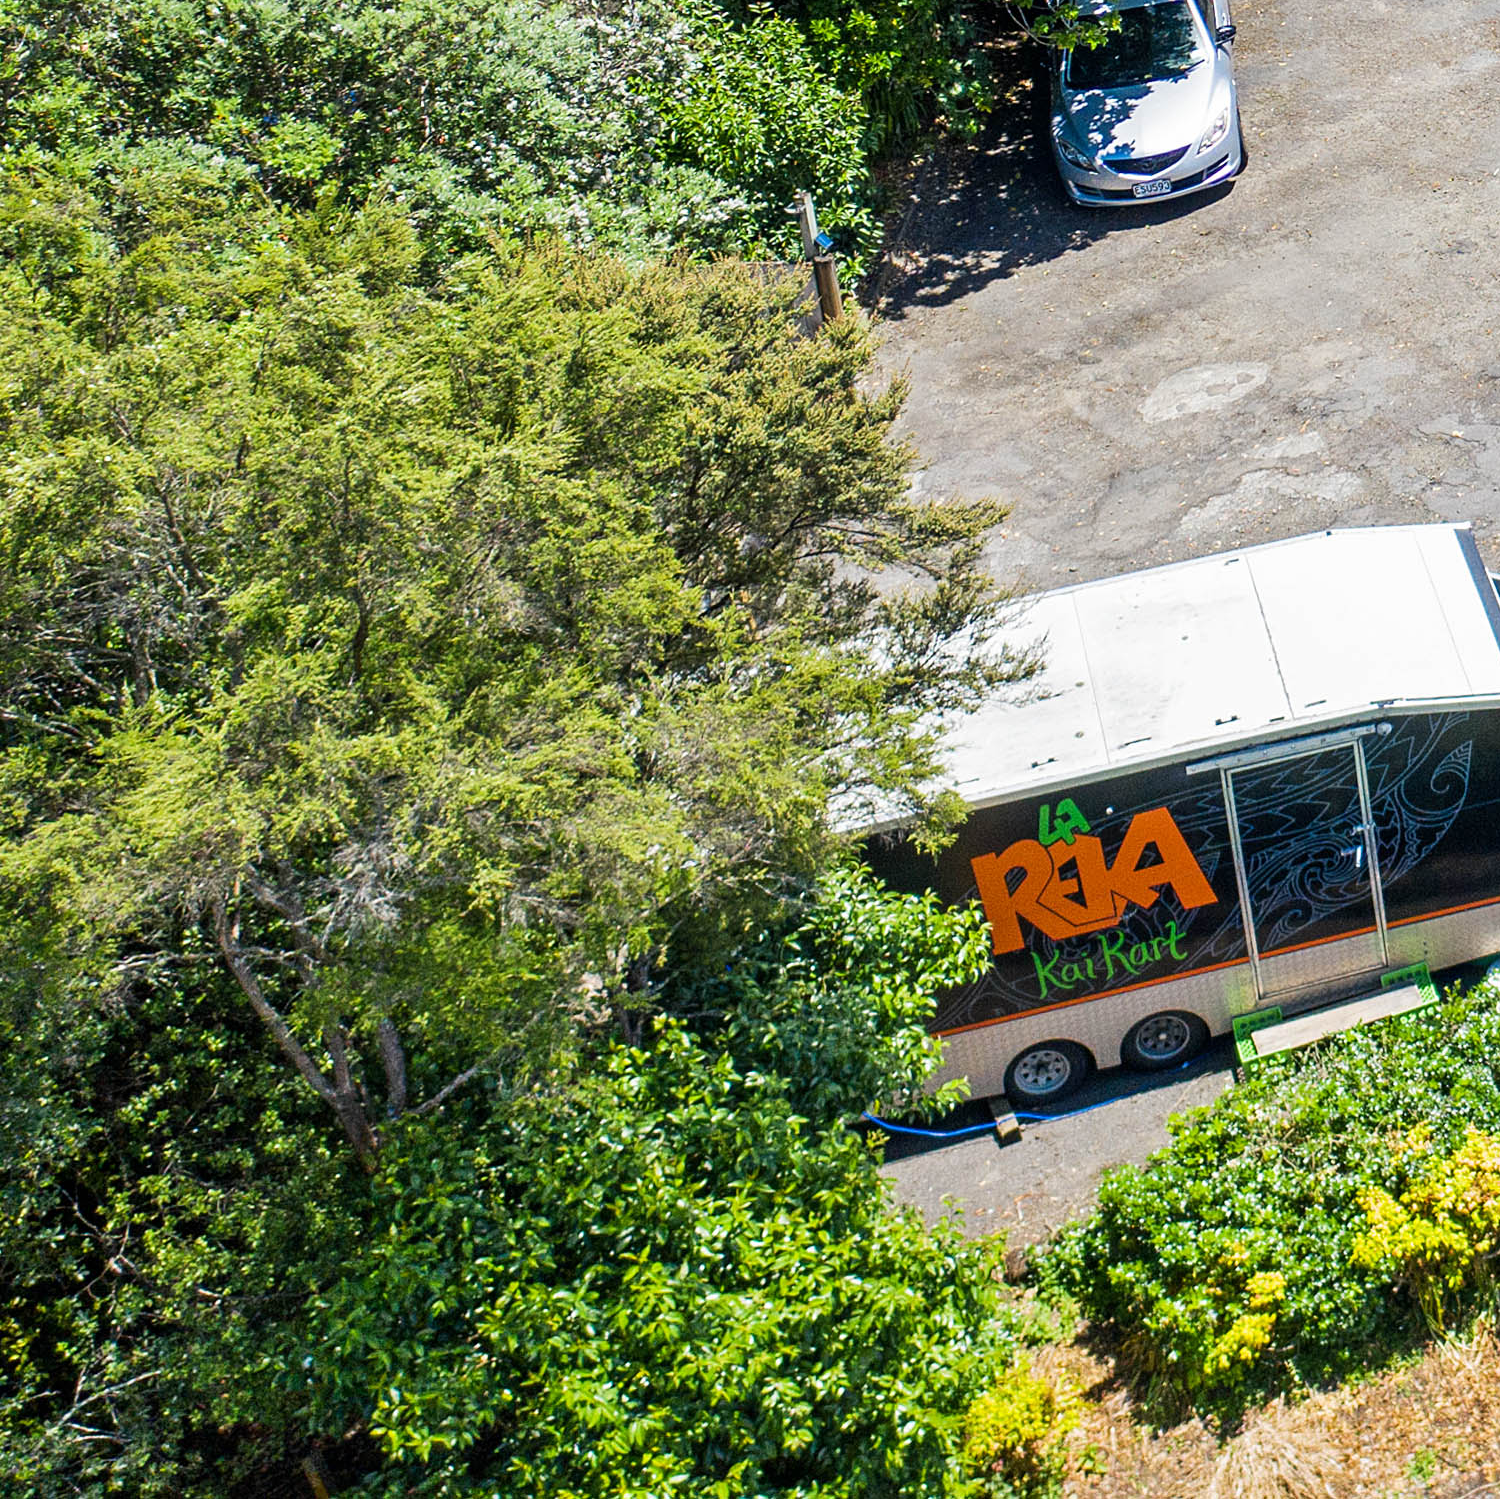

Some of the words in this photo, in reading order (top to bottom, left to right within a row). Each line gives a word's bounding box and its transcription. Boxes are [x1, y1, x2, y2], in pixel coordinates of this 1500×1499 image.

[1038, 798, 1091, 845] LA
[970, 806, 1219, 956] REKA
[1030, 948, 1096, 999] Kai
[1097, 920, 1188, 981] Kart
